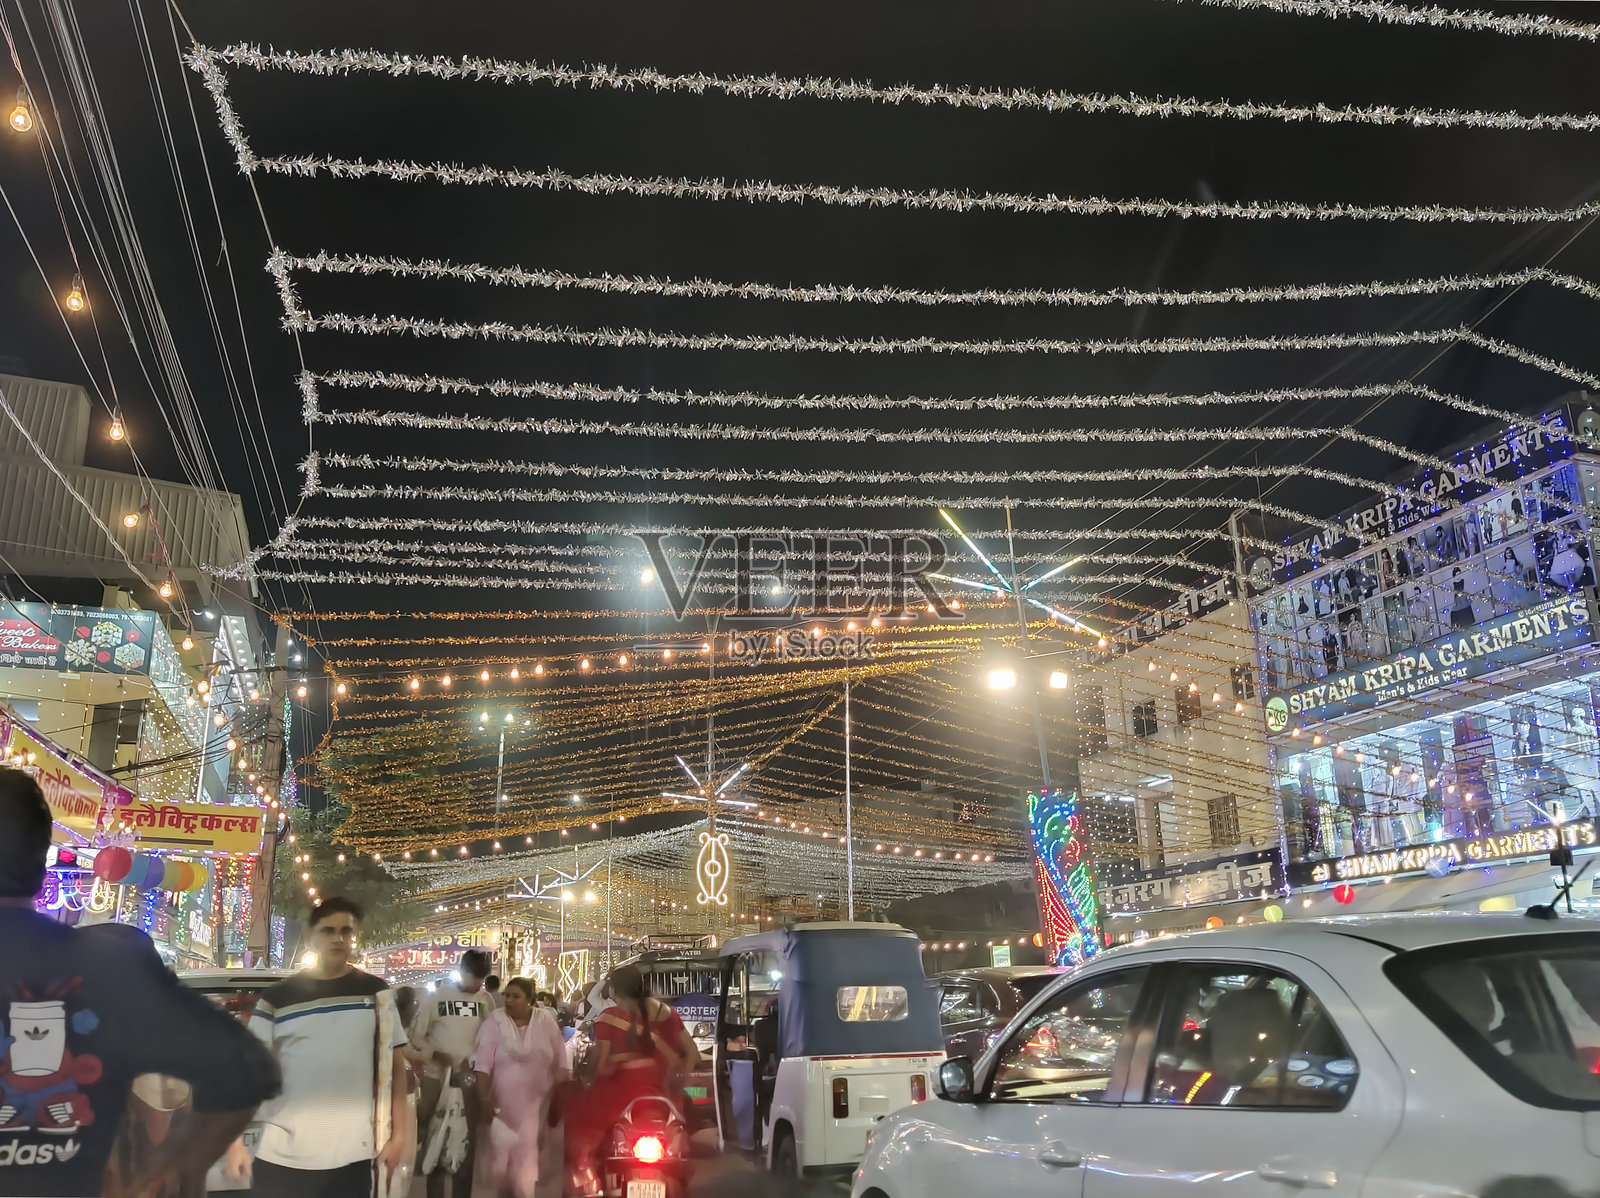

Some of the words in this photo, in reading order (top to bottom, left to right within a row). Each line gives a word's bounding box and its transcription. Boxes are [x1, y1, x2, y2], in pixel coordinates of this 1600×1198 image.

[1346, 493, 1414, 533] KRIPA
[1420, 418, 1568, 499] GARMENTS
[1290, 675, 1360, 714] SHYAM
[1362, 652, 1434, 691] KRIPA
[1438, 600, 1590, 667] GARMENTS
[1375, 686, 1405, 702] Men's
[1407, 682, 1416, 693] &
[1417, 674, 1440, 690] Kids
[1441, 667, 1468, 682] Wear
[1335, 851, 1399, 878] SHYAM
[1401, 843, 1461, 869] KRIPA
[1467, 822, 1596, 860] GARMENTS
